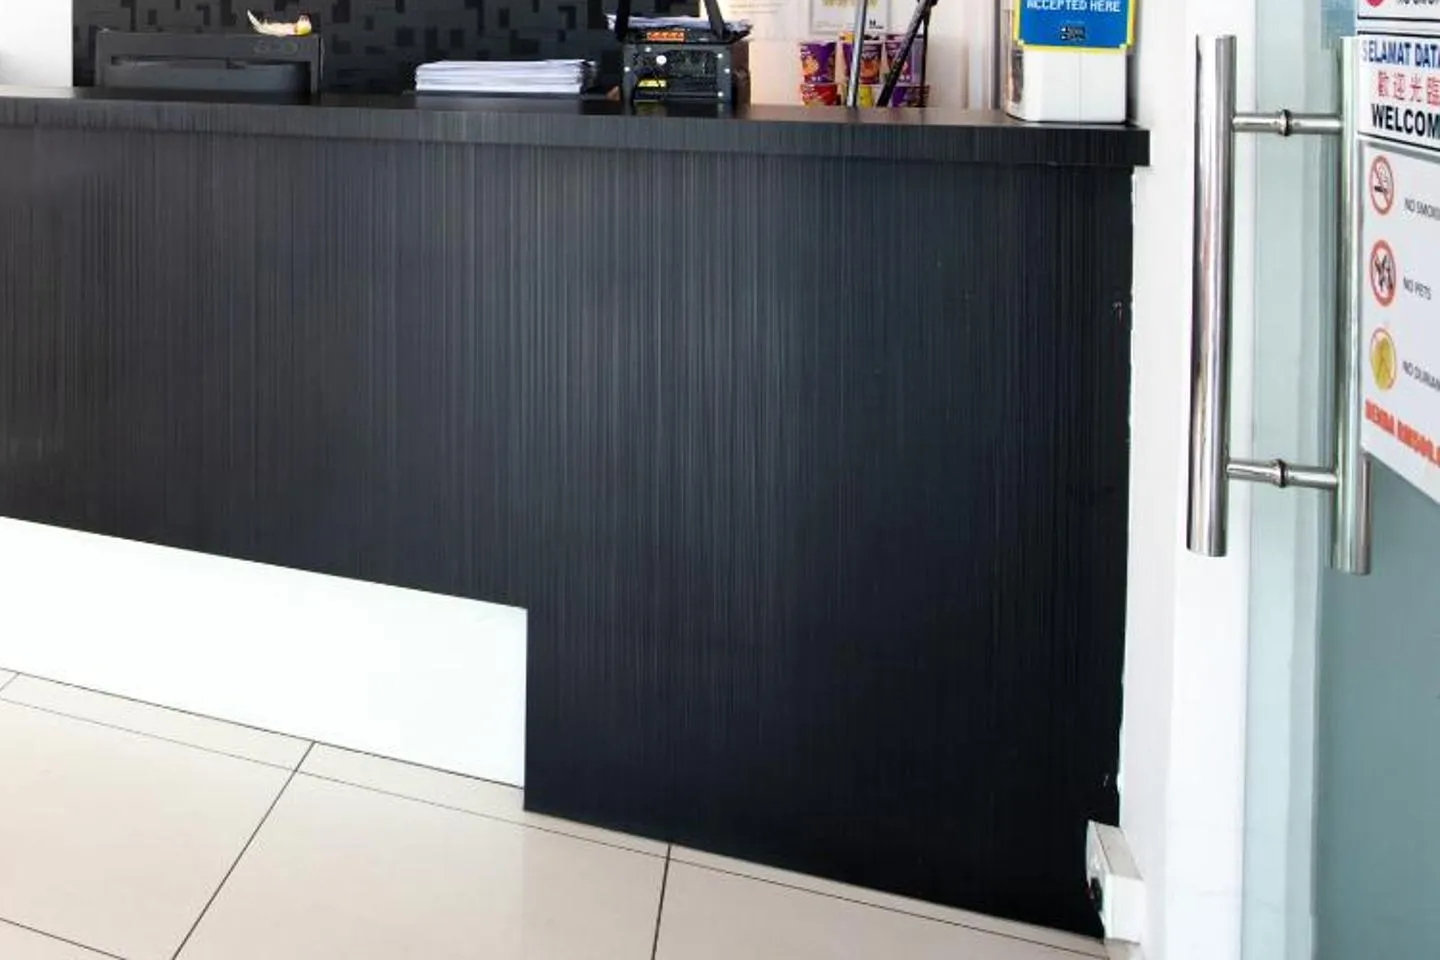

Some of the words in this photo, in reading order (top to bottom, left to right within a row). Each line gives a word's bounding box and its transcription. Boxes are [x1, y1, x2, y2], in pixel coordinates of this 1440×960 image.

[1090, 0, 1121, 13] HERE
[1361, 39, 1412, 66] SELAMAT
[1404, 198, 1416, 212] NO
[1403, 276, 1414, 294] NO
[1415, 281, 1432, 301] PETS
[1403, 360, 1414, 377] NO
